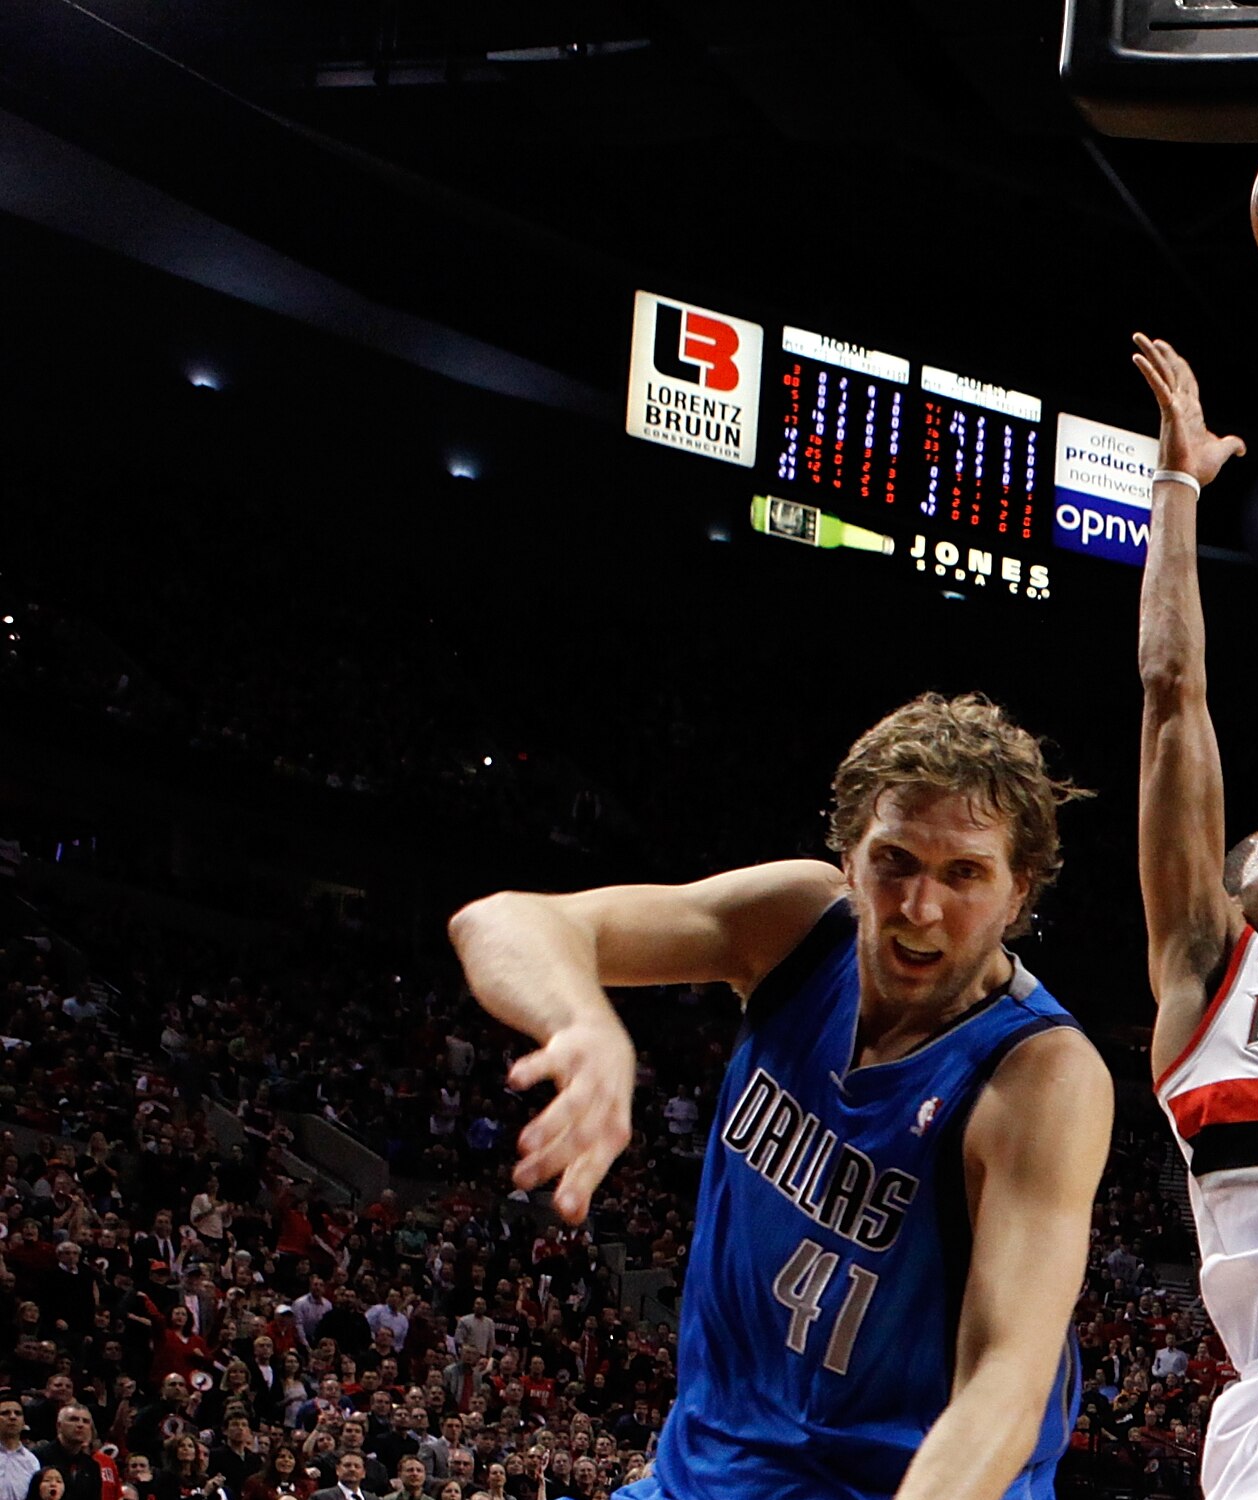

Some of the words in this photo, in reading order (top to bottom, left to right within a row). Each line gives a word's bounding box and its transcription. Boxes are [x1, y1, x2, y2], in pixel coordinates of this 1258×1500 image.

[646, 383, 742, 425] LORENTZ
[643, 427, 741, 459] CONSTRUCTION
[645, 404, 741, 448] BRUUN
[1090, 435, 1135, 455] office
[1065, 446, 1155, 479] products
[1069, 468, 1151, 499] northwest
[1056, 504, 1151, 547] opnw
[910, 534, 1049, 588] JONES
[916, 559, 986, 586] SODA
[721, 1067, 921, 1253] DALLAS
[772, 1237, 879, 1376] 41
